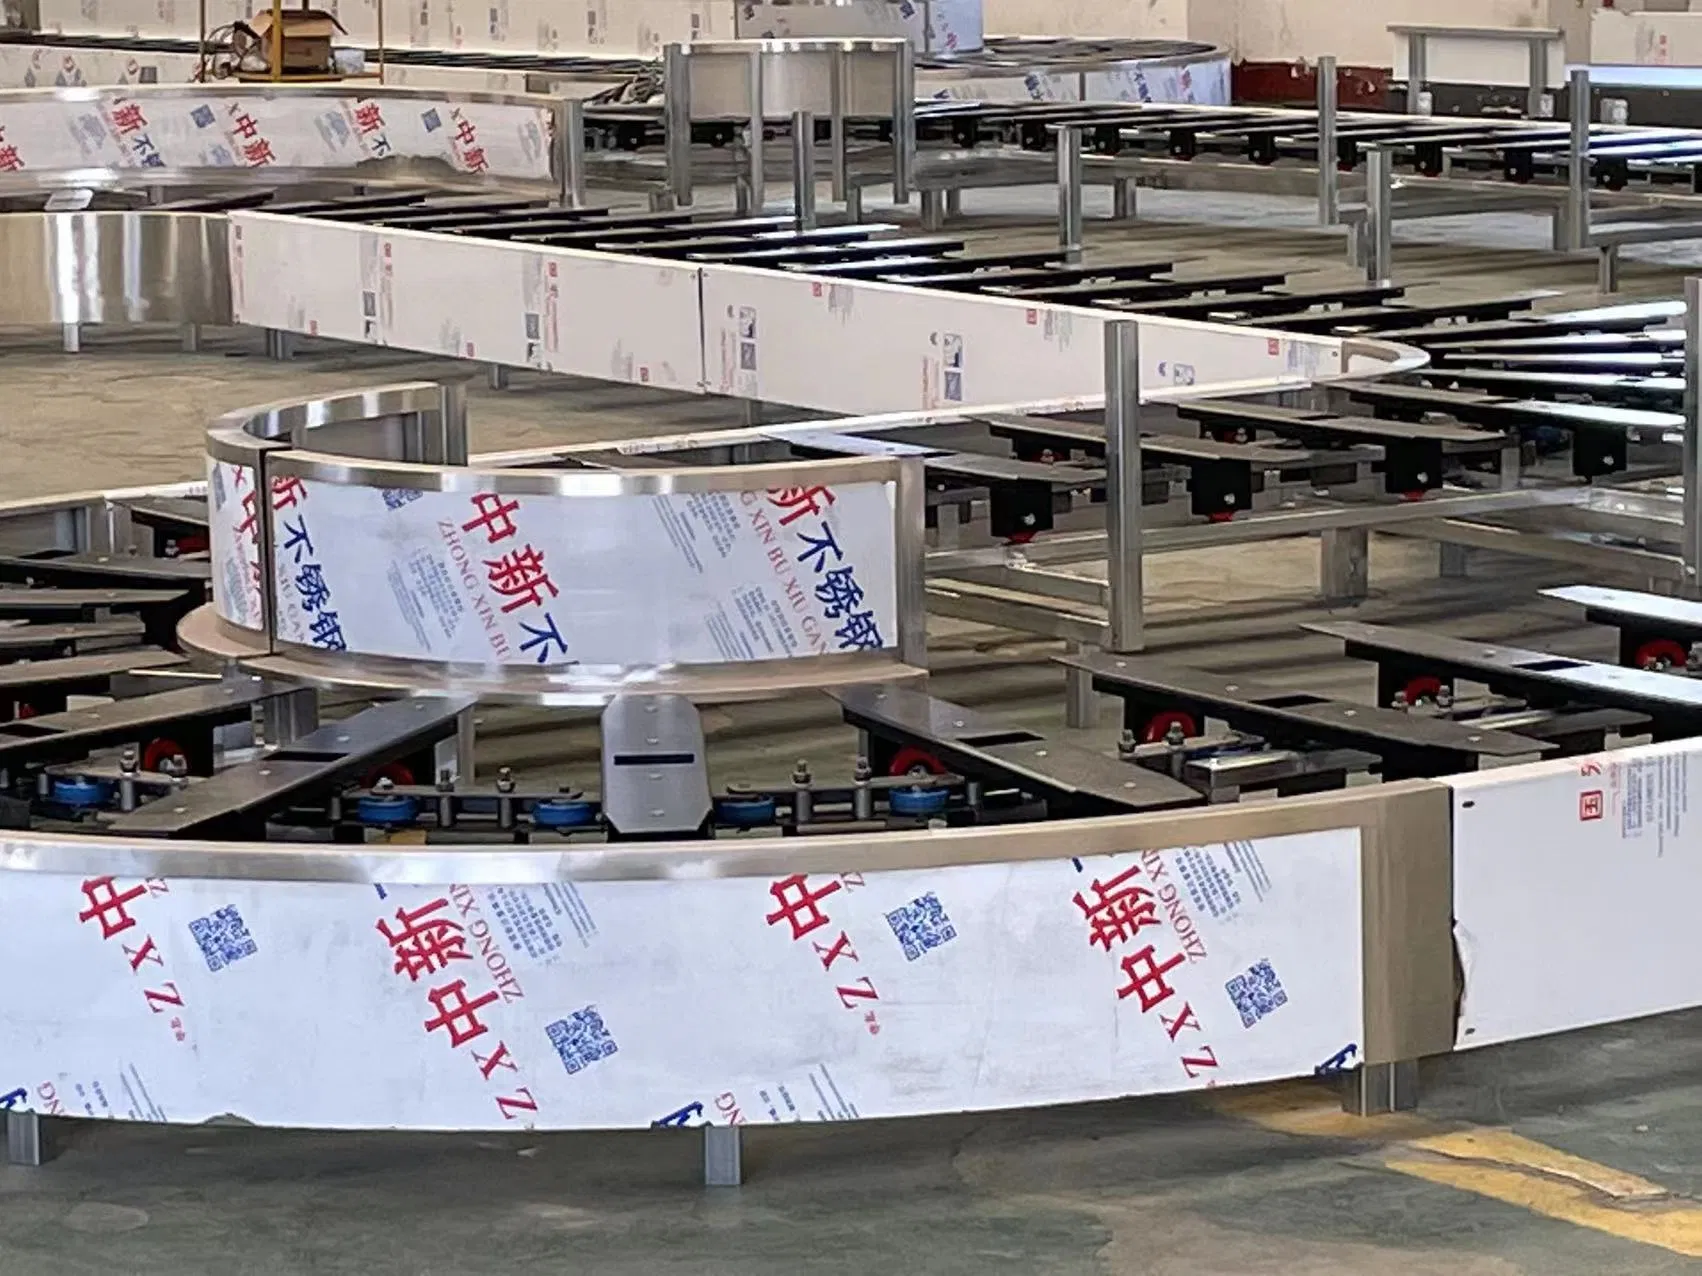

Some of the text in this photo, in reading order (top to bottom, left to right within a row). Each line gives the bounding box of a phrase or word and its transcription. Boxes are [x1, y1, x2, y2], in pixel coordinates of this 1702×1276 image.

[112, 97, 167, 167] 新不
[233, 113, 276, 168] 中新
[355, 97, 391, 156] 新不
[437, 519, 480, 590] ZHONG
[472, 593, 497, 632] XIN
[461, 492, 568, 663] 中新不
[748, 507, 778, 546] XIN
[766, 549, 789, 577] BU
[783, 577, 810, 617] XIU
[79, 876, 148, 940] 中
[766, 873, 842, 941] 中
[1072, 857, 1186, 1014] 中新
[1157, 882, 1209, 965] ZHONG
[374, 883, 500, 1048] 中新
[467, 918, 526, 1005] ZHONG
